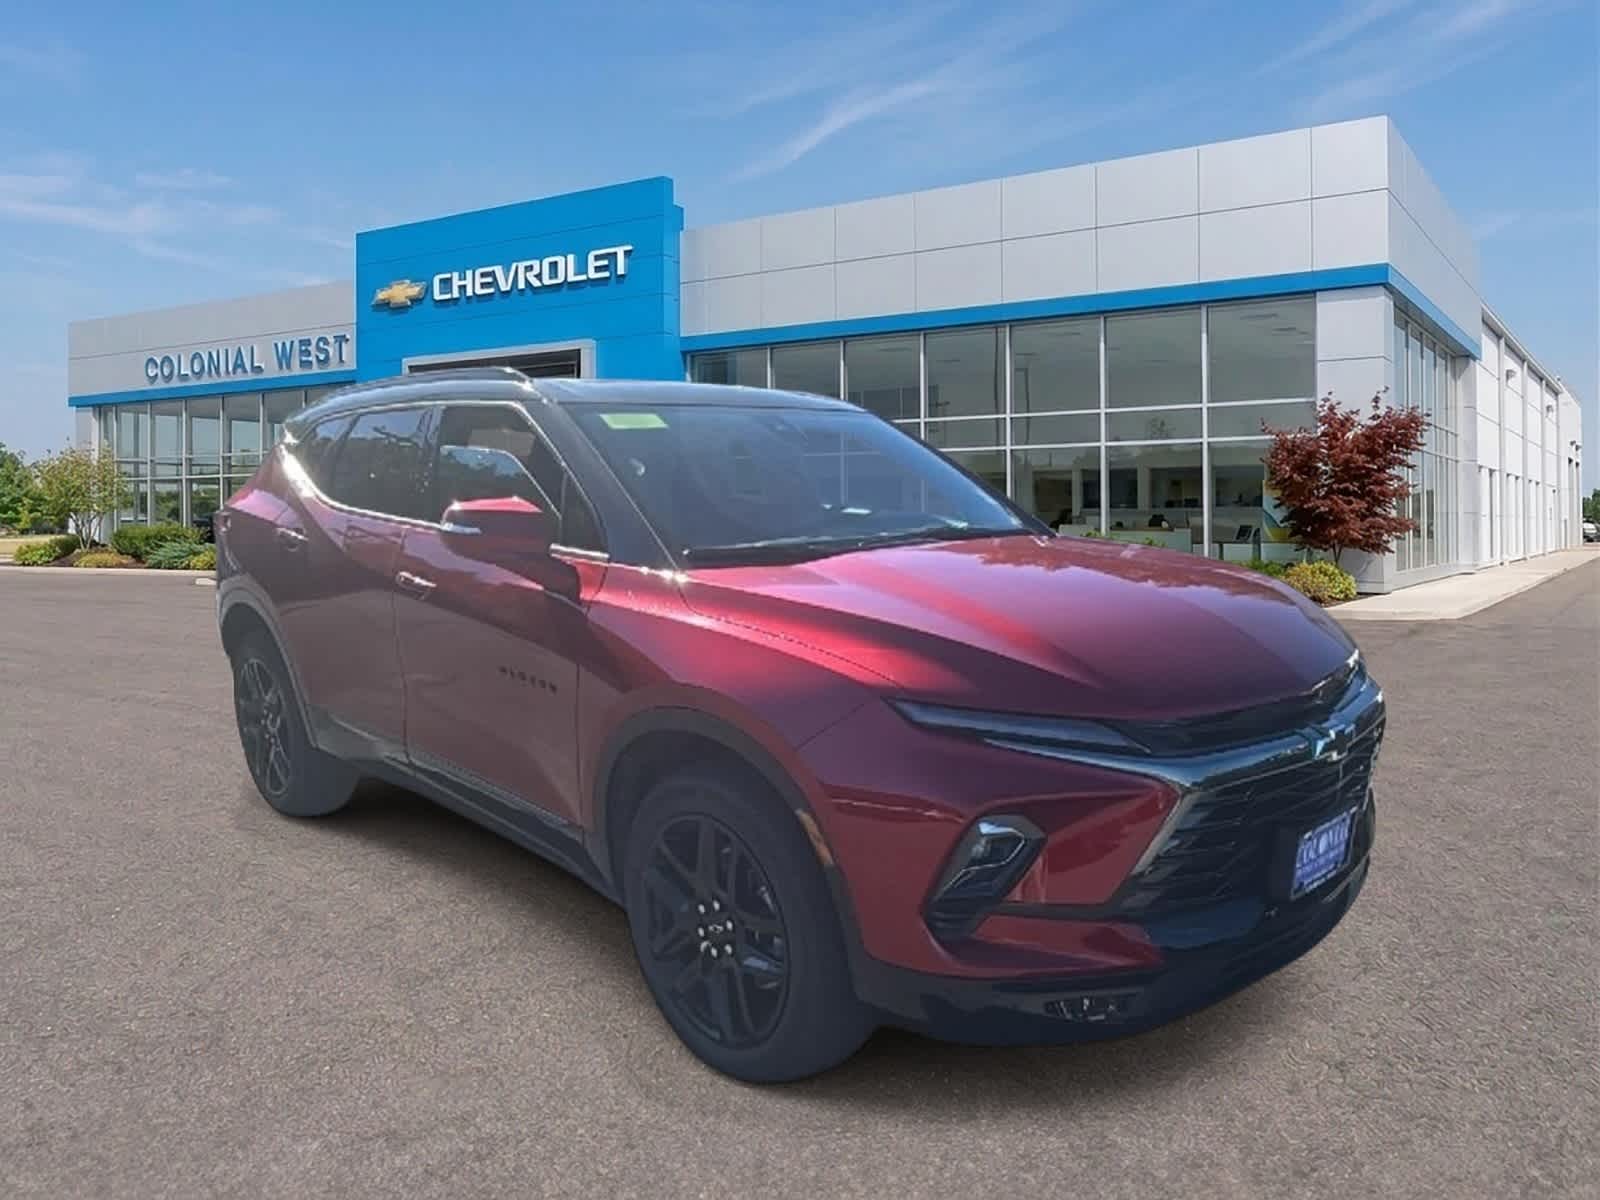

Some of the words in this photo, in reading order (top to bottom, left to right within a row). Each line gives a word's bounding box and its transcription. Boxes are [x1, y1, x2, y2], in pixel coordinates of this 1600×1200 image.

[432, 244, 633, 302] CHEVROLET
[144, 345, 264, 382] COLONIAL
[273, 333, 349, 371] WEST
